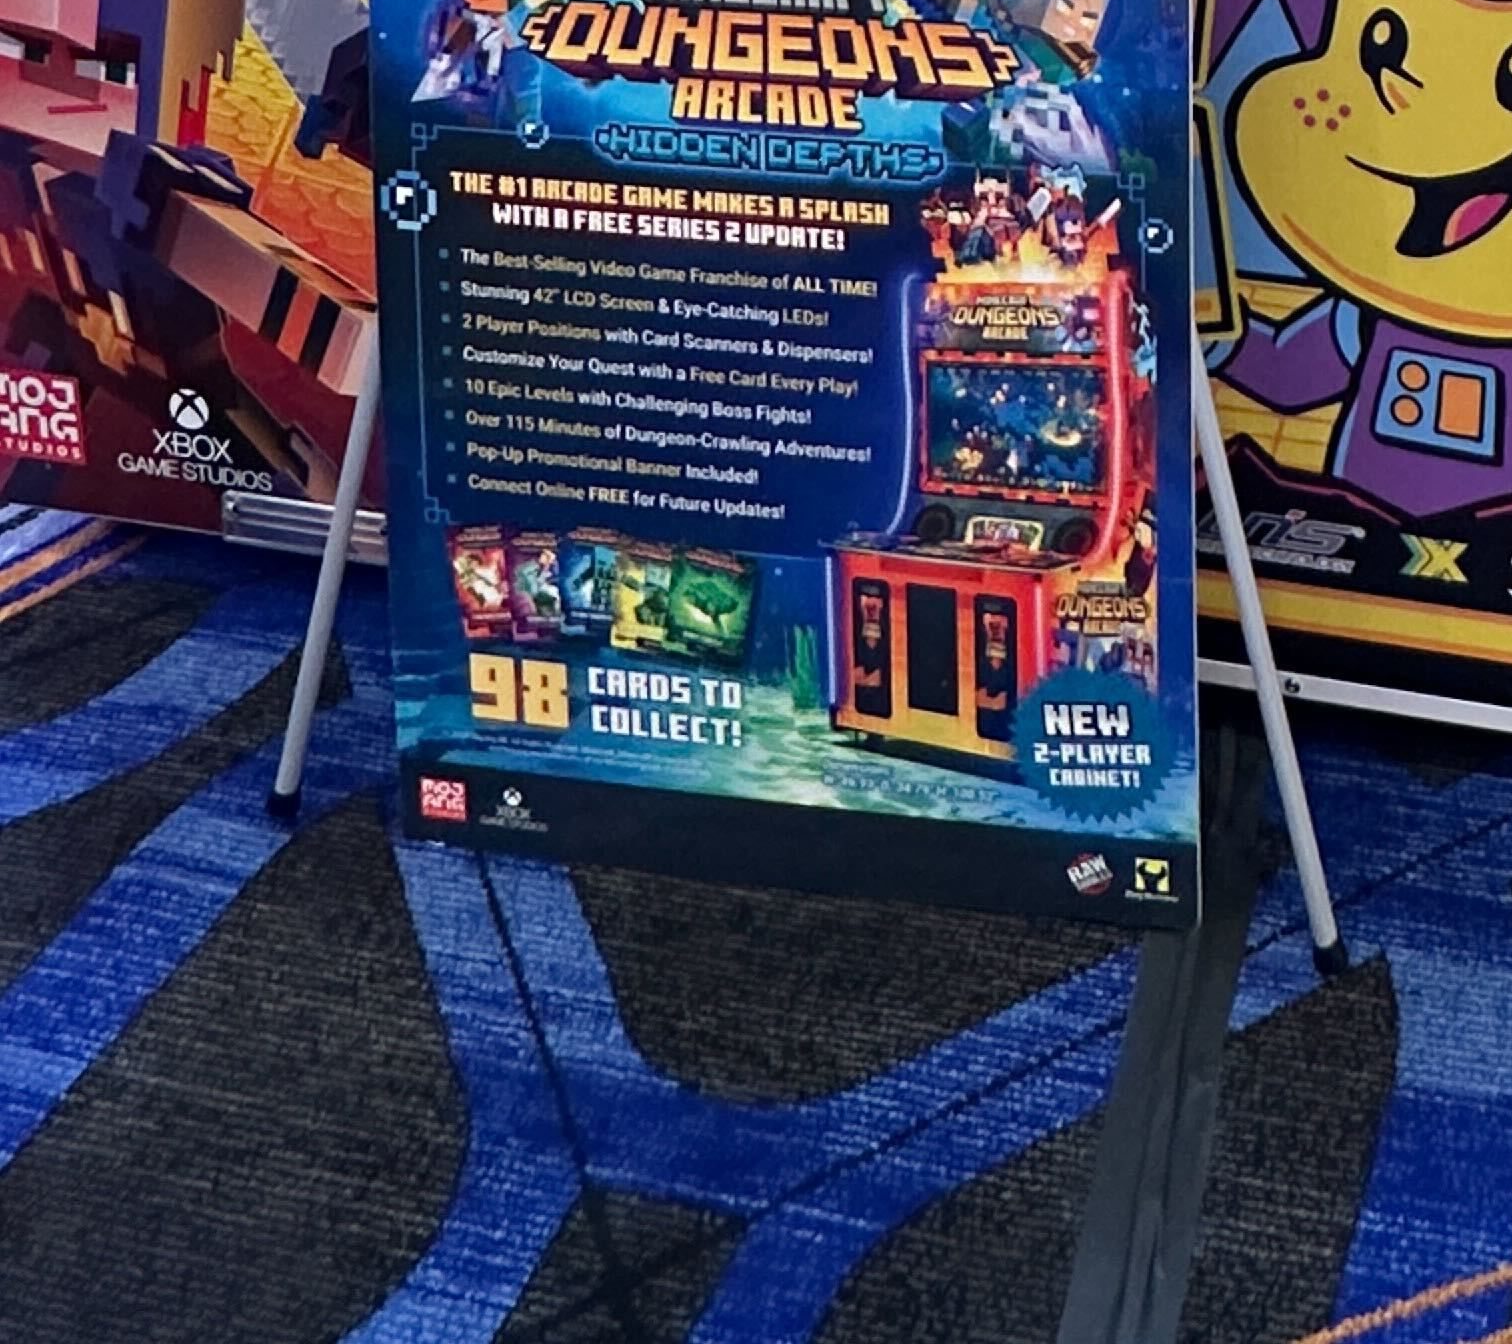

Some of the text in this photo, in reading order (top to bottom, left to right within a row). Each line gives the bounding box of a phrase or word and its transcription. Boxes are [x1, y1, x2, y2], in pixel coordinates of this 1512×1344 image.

[547, 1, 1000, 94] DUNGEONS
[672, 78, 863, 131] ARCADE
[609, 124, 759, 167] HIDDEN
[450, 171, 492, 195] THE
[532, 177, 617, 206] ARCADE
[624, 184, 687, 211] GAME
[694, 190, 774, 218] MAKES
[799, 198, 889, 226] SPLASH
[493, 203, 550, 228] WITH
[574, 209, 633, 234] FREE
[638, 214, 720, 242] SERIES
[726, 221, 740, 242] 2
[745, 223, 845, 250] UPDATE!
[461, 248, 877, 298] The Best-Selling Video Game Franchise of ALL TIME!
[461, 280, 530, 306] Stunning
[564, 288, 595, 308] LCD
[600, 291, 654, 312] Screen
[658, 296, 670, 314] &
[674, 298, 779, 326] Eye-Catching
[462, 314, 873, 365] 2 Player Positions with Card Scanners & Dispensers!
[463, 345, 545, 369] Customize
[549, 352, 584, 371] Your
[589, 356, 635, 378] Quest
[639, 360, 672, 380] with
[676, 367, 686, 382] a
[690, 365, 724, 385] Free
[729, 369, 766, 389] Card
[771, 373, 815, 396] Every
[465, 377, 811, 424] 10 Epic Levels with Challenging Boss Fights!
[0, 438, 82, 459] TUDIOS
[152, 429, 234, 463] XBOX
[466, 409, 871, 462] Over 115 Minutes of Dungeon-Crawling Adventures!
[117, 452, 273, 492] GAME STUDIOS
[467, 442, 523, 465] Pop-Up
[527, 447, 622, 472] Promotional
[626, 457, 682, 477] Banner
[468, 474, 785, 519] Connect Online FREE for Future Updates!
[469, 650, 743, 730] 98 CARDS TO
[591, 708, 743, 749] COLLECT!
[1043, 703, 1130, 737] NEW
[1033, 742, 1152, 766] 2-PLAYER
[1049, 767, 1141, 789] CABINET!
